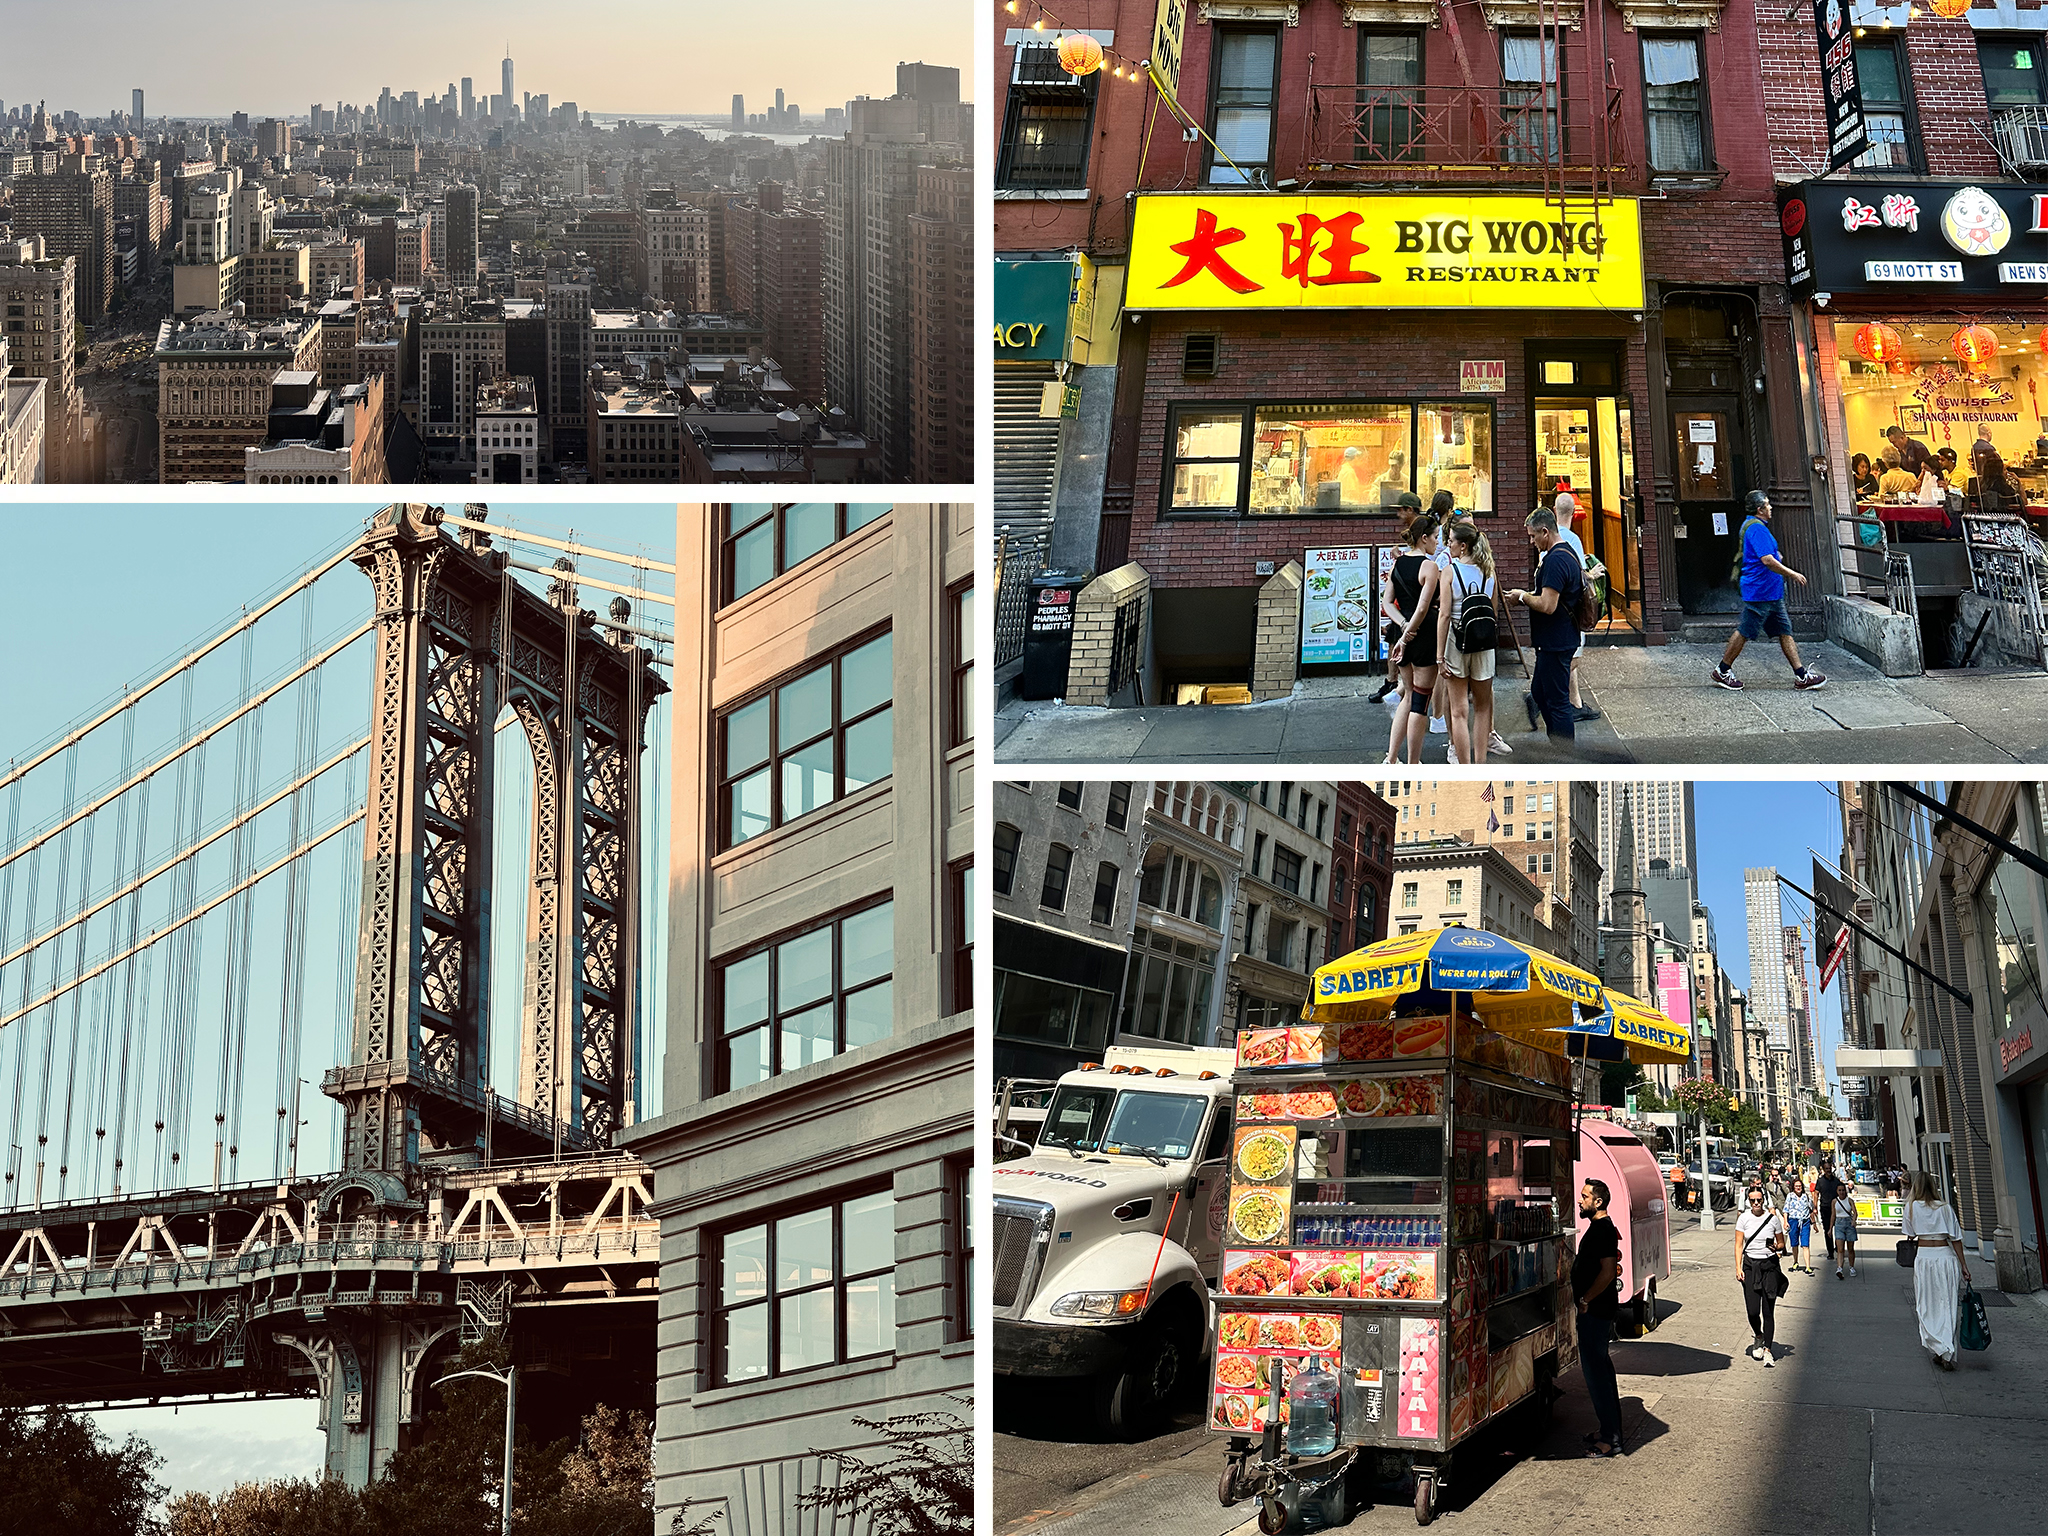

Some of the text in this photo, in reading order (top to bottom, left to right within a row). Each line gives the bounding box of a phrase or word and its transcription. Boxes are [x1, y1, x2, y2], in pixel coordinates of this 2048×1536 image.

[1166, 0, 1181, 44] BIG
[1157, 24, 1180, 90] WONG
[1825, 31, 1852, 72] 456
[1841, 193, 1921, 234] 江浙
[1394, 220, 1608, 255] BIG WONG
[1156, 208, 1382, 294] 大旺
[1792, 250, 1806, 272] 456
[1405, 266, 1600, 283] RESTAURANT
[1874, 263, 1957, 278] 69 MOTT ST
[2009, 265, 2036, 280] NEW
[993, 322, 1044, 347] ACY
[1462, 362, 1504, 378] ATM
[1936, 398, 1990, 407] NEW 456
[1913, 412, 2018, 422] SHANGHAI RESTAURANT
[1316, 550, 1359, 561] 大旺饭店
[1033, 614, 1072, 622] PHARMACY
[1038, 606, 1069, 614] PEOPLES
[1319, 961, 1421, 996] SABRETT
[1439, 969, 1465, 977] WE'RE
[1467, 970, 1478, 978] ON
[1488, 970, 1508, 979] ROLL
[1511, 970, 1520, 979] !!!
[1539, 966, 1601, 1001] SABRETT
[1659, 988, 1669, 1018] ATIRON
[1619, 1019, 1686, 1048] SABRETT
[1238, 1128, 1292, 1146] CHICKEN OVER RICE
[1408, 1337, 1428, 1432] HALAL
